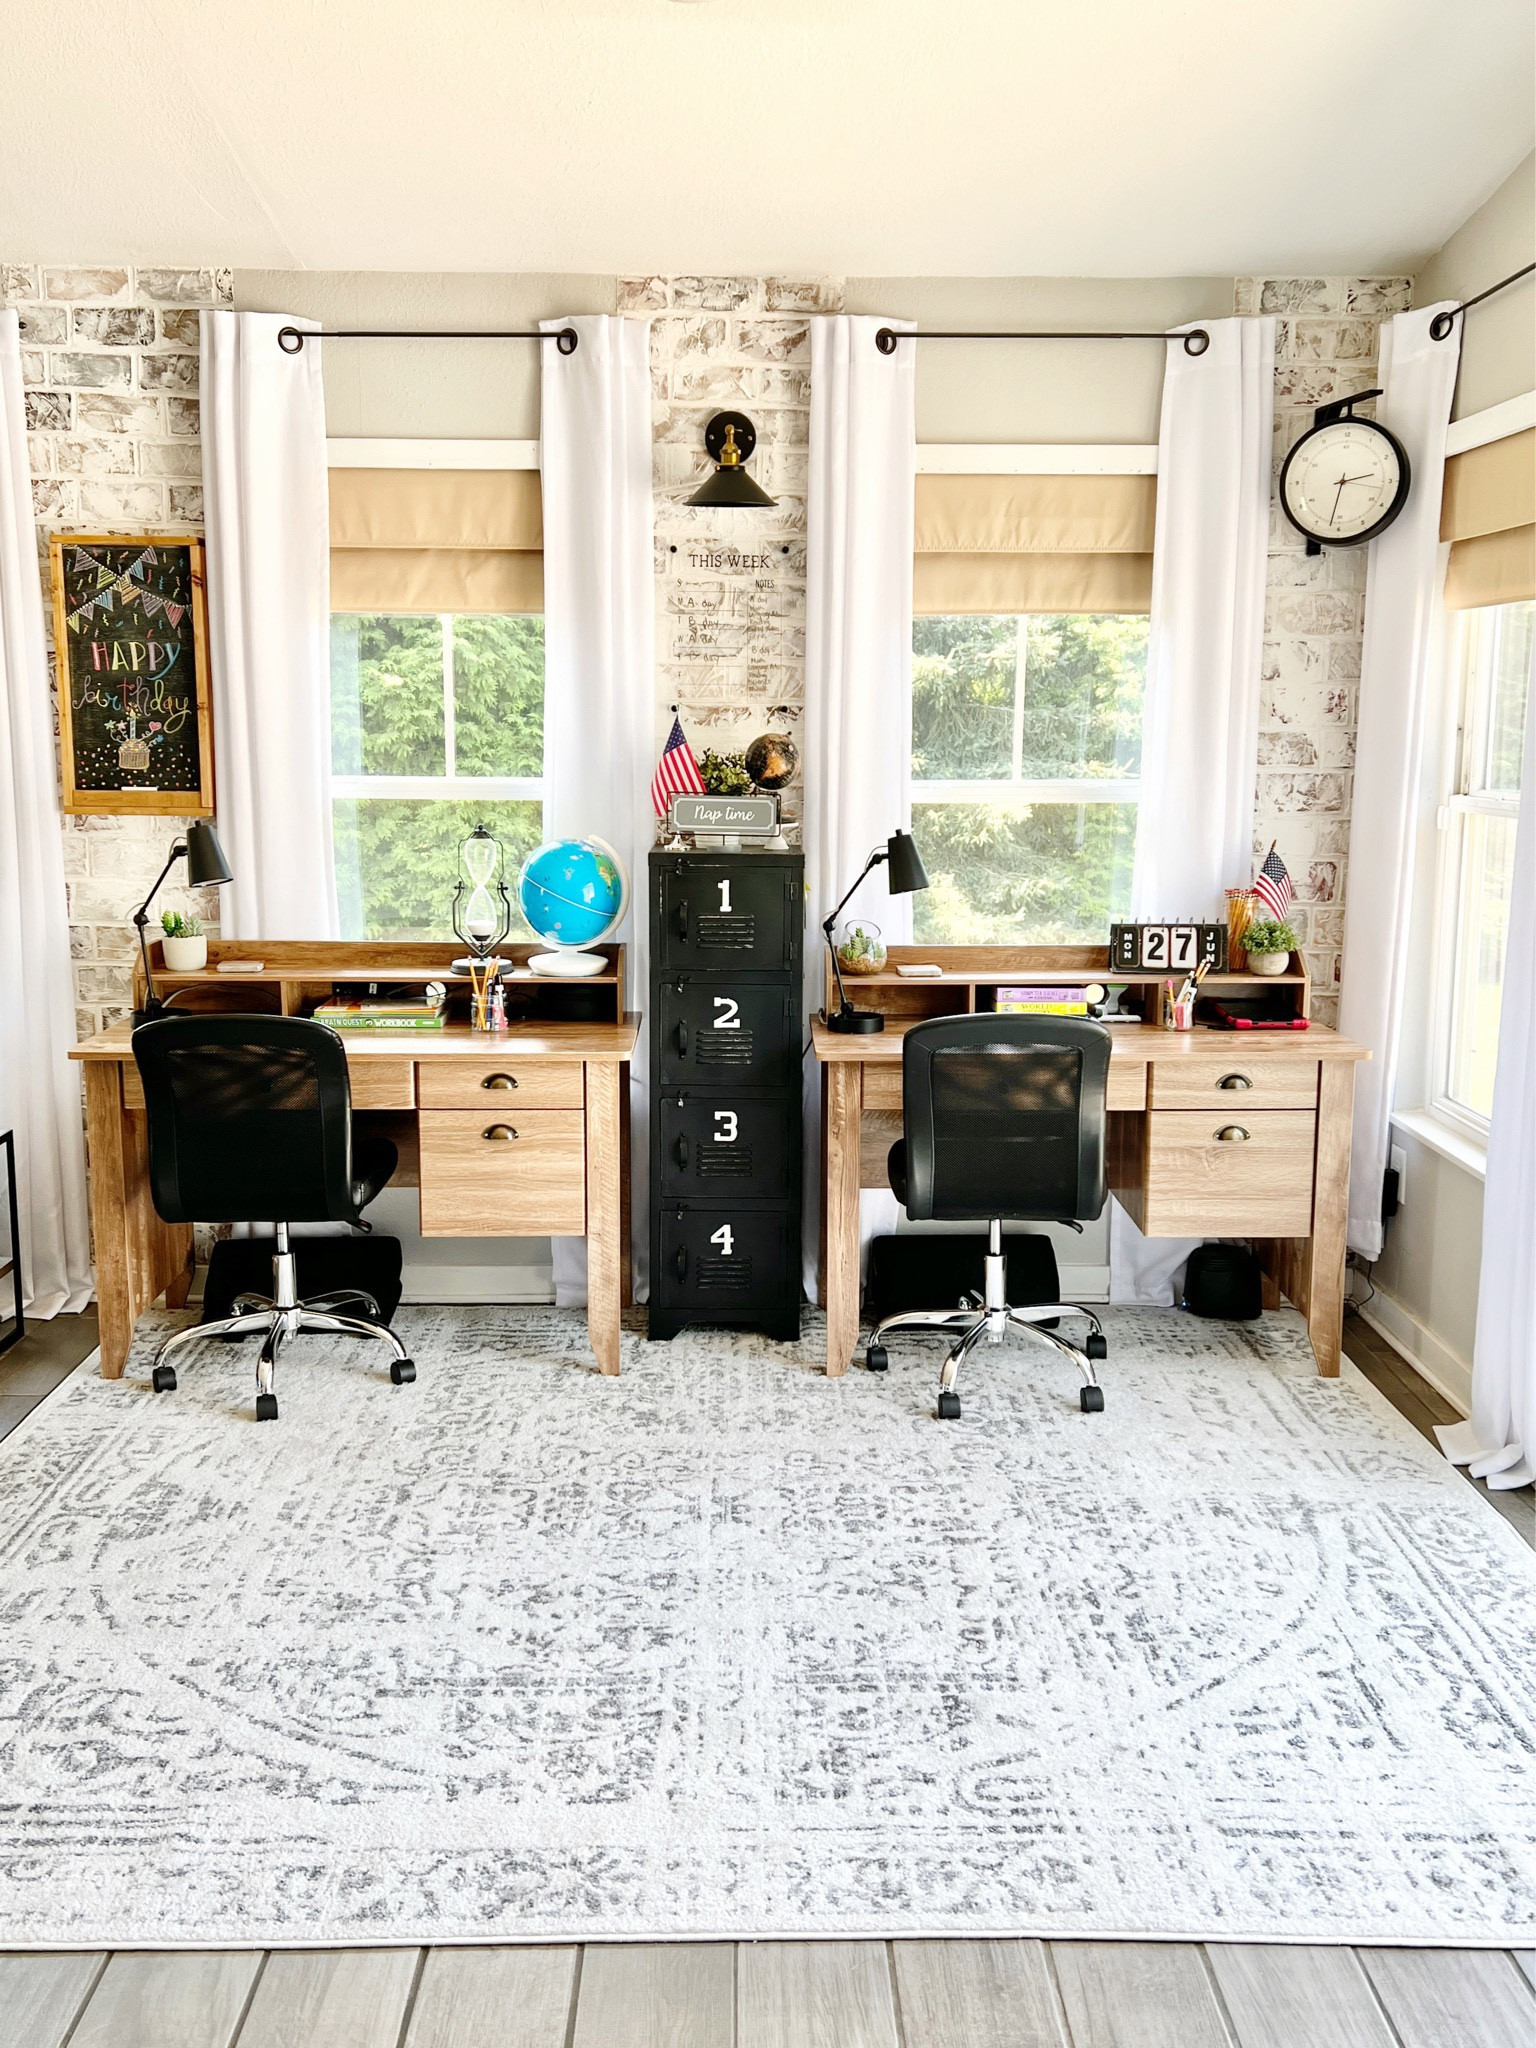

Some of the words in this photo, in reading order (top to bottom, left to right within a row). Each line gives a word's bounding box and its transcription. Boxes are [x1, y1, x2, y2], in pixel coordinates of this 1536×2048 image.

[689, 554, 722, 568] THIS
[728, 555, 770, 568] WEEK
[755, 580, 774, 589] NOTES
[90, 641, 181, 681] HAPPY
[72, 674, 192, 734] birthday
[694, 805, 723, 824] Nap
[725, 806, 756, 821] time
[717, 879, 732, 912] 1
[1123, 933, 1133, 959] MON
[1147, 932, 1192, 961] 27
[1206, 931, 1216, 963] JUN
[343, 1018, 363, 1026] QUEST
[375, 1019, 417, 1027] WORKBOOK
[713, 997, 740, 1028] 2
[713, 1111, 738, 1141] 3
[710, 1224, 734, 1255] 4
